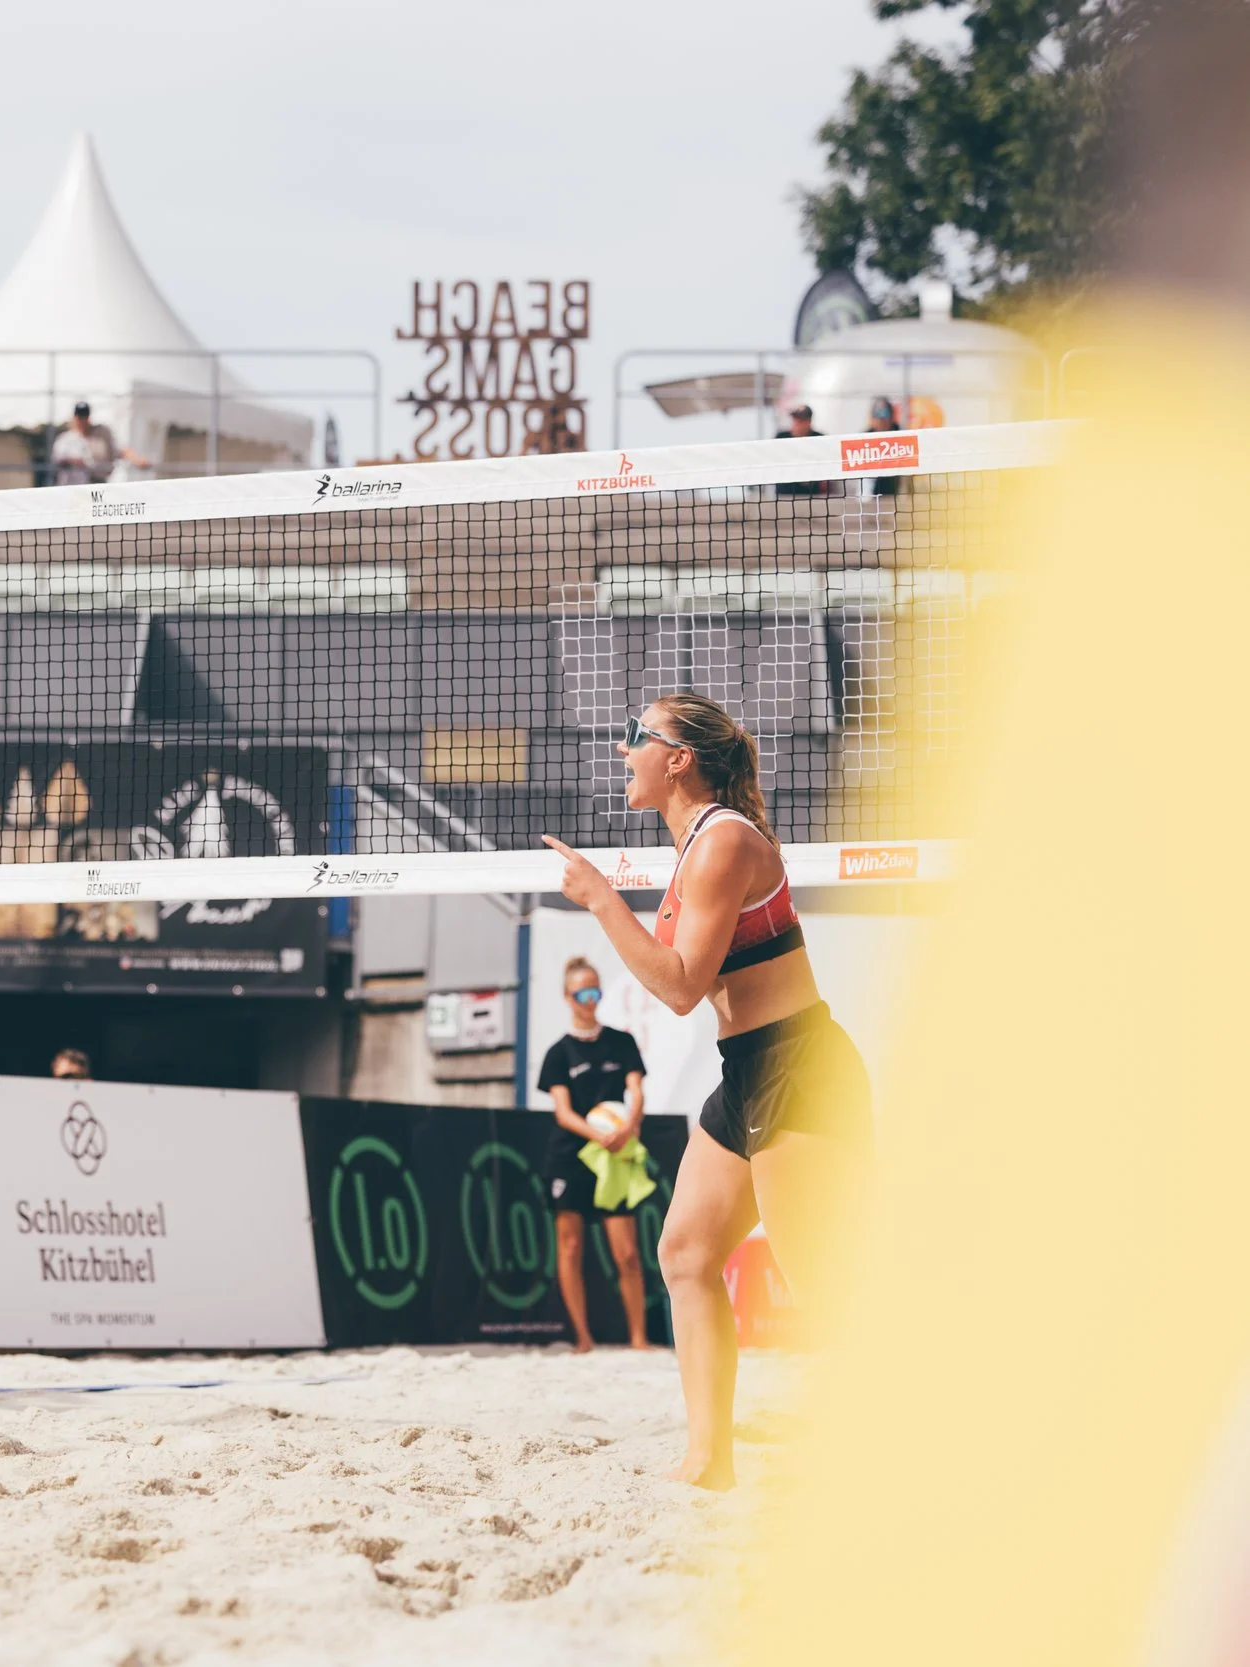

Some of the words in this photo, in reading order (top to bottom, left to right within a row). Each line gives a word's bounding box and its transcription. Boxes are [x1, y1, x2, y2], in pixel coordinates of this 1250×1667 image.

[845, 441, 914, 468] win2day
[91, 490, 104, 503] MY
[332, 480, 402, 497] ballarina
[92, 502, 146, 517] BEACHEVENT
[844, 851, 914, 876] win2day
[87, 869, 101, 882] MY
[328, 869, 399, 885] ballarina
[86, 882, 141, 896] BEACHEVENT
[16, 1198, 167, 1237] Schlosshotel
[39, 1246, 156, 1284] Kitzbühel
